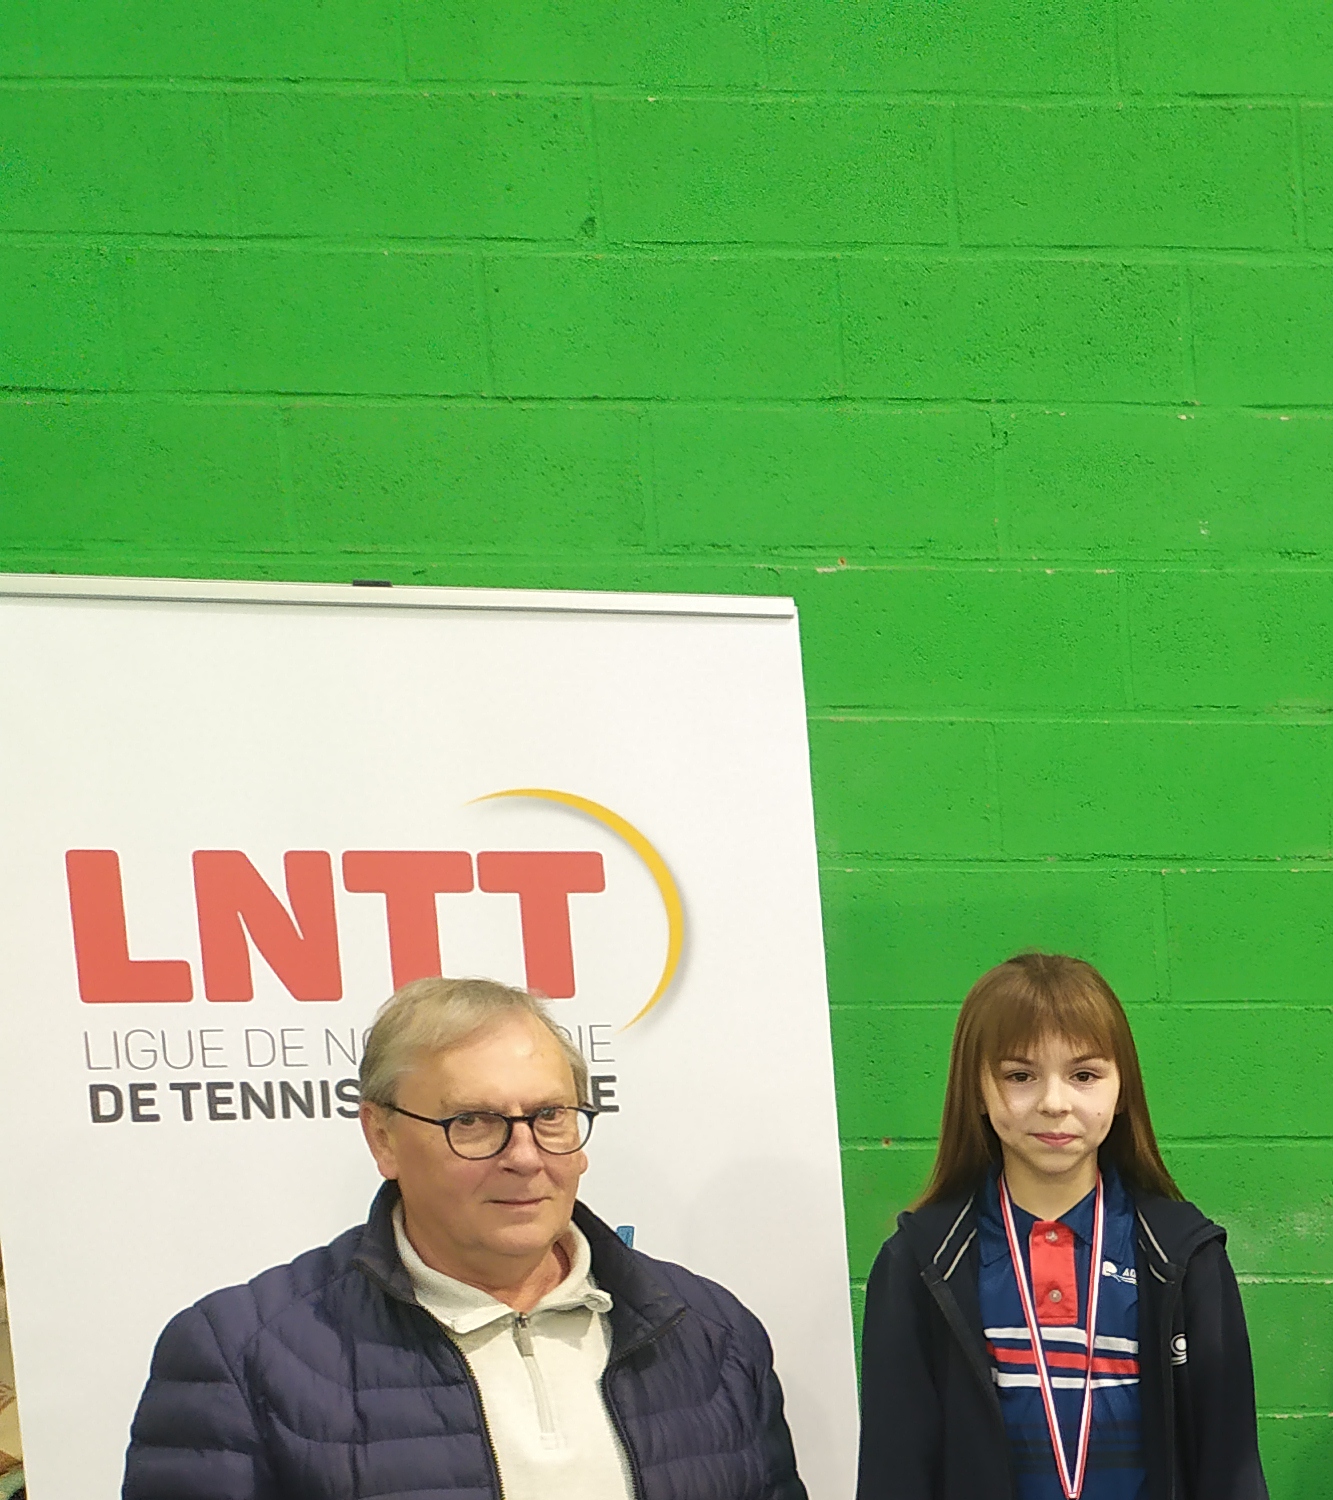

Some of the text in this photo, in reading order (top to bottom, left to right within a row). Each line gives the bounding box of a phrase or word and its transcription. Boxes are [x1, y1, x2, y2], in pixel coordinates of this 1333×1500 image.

[65, 849, 606, 1004] LNTT
[83, 1028, 228, 1071] LIGUE
[244, 1027, 309, 1068] DE
[88, 1078, 362, 1124] DE TENNIS
